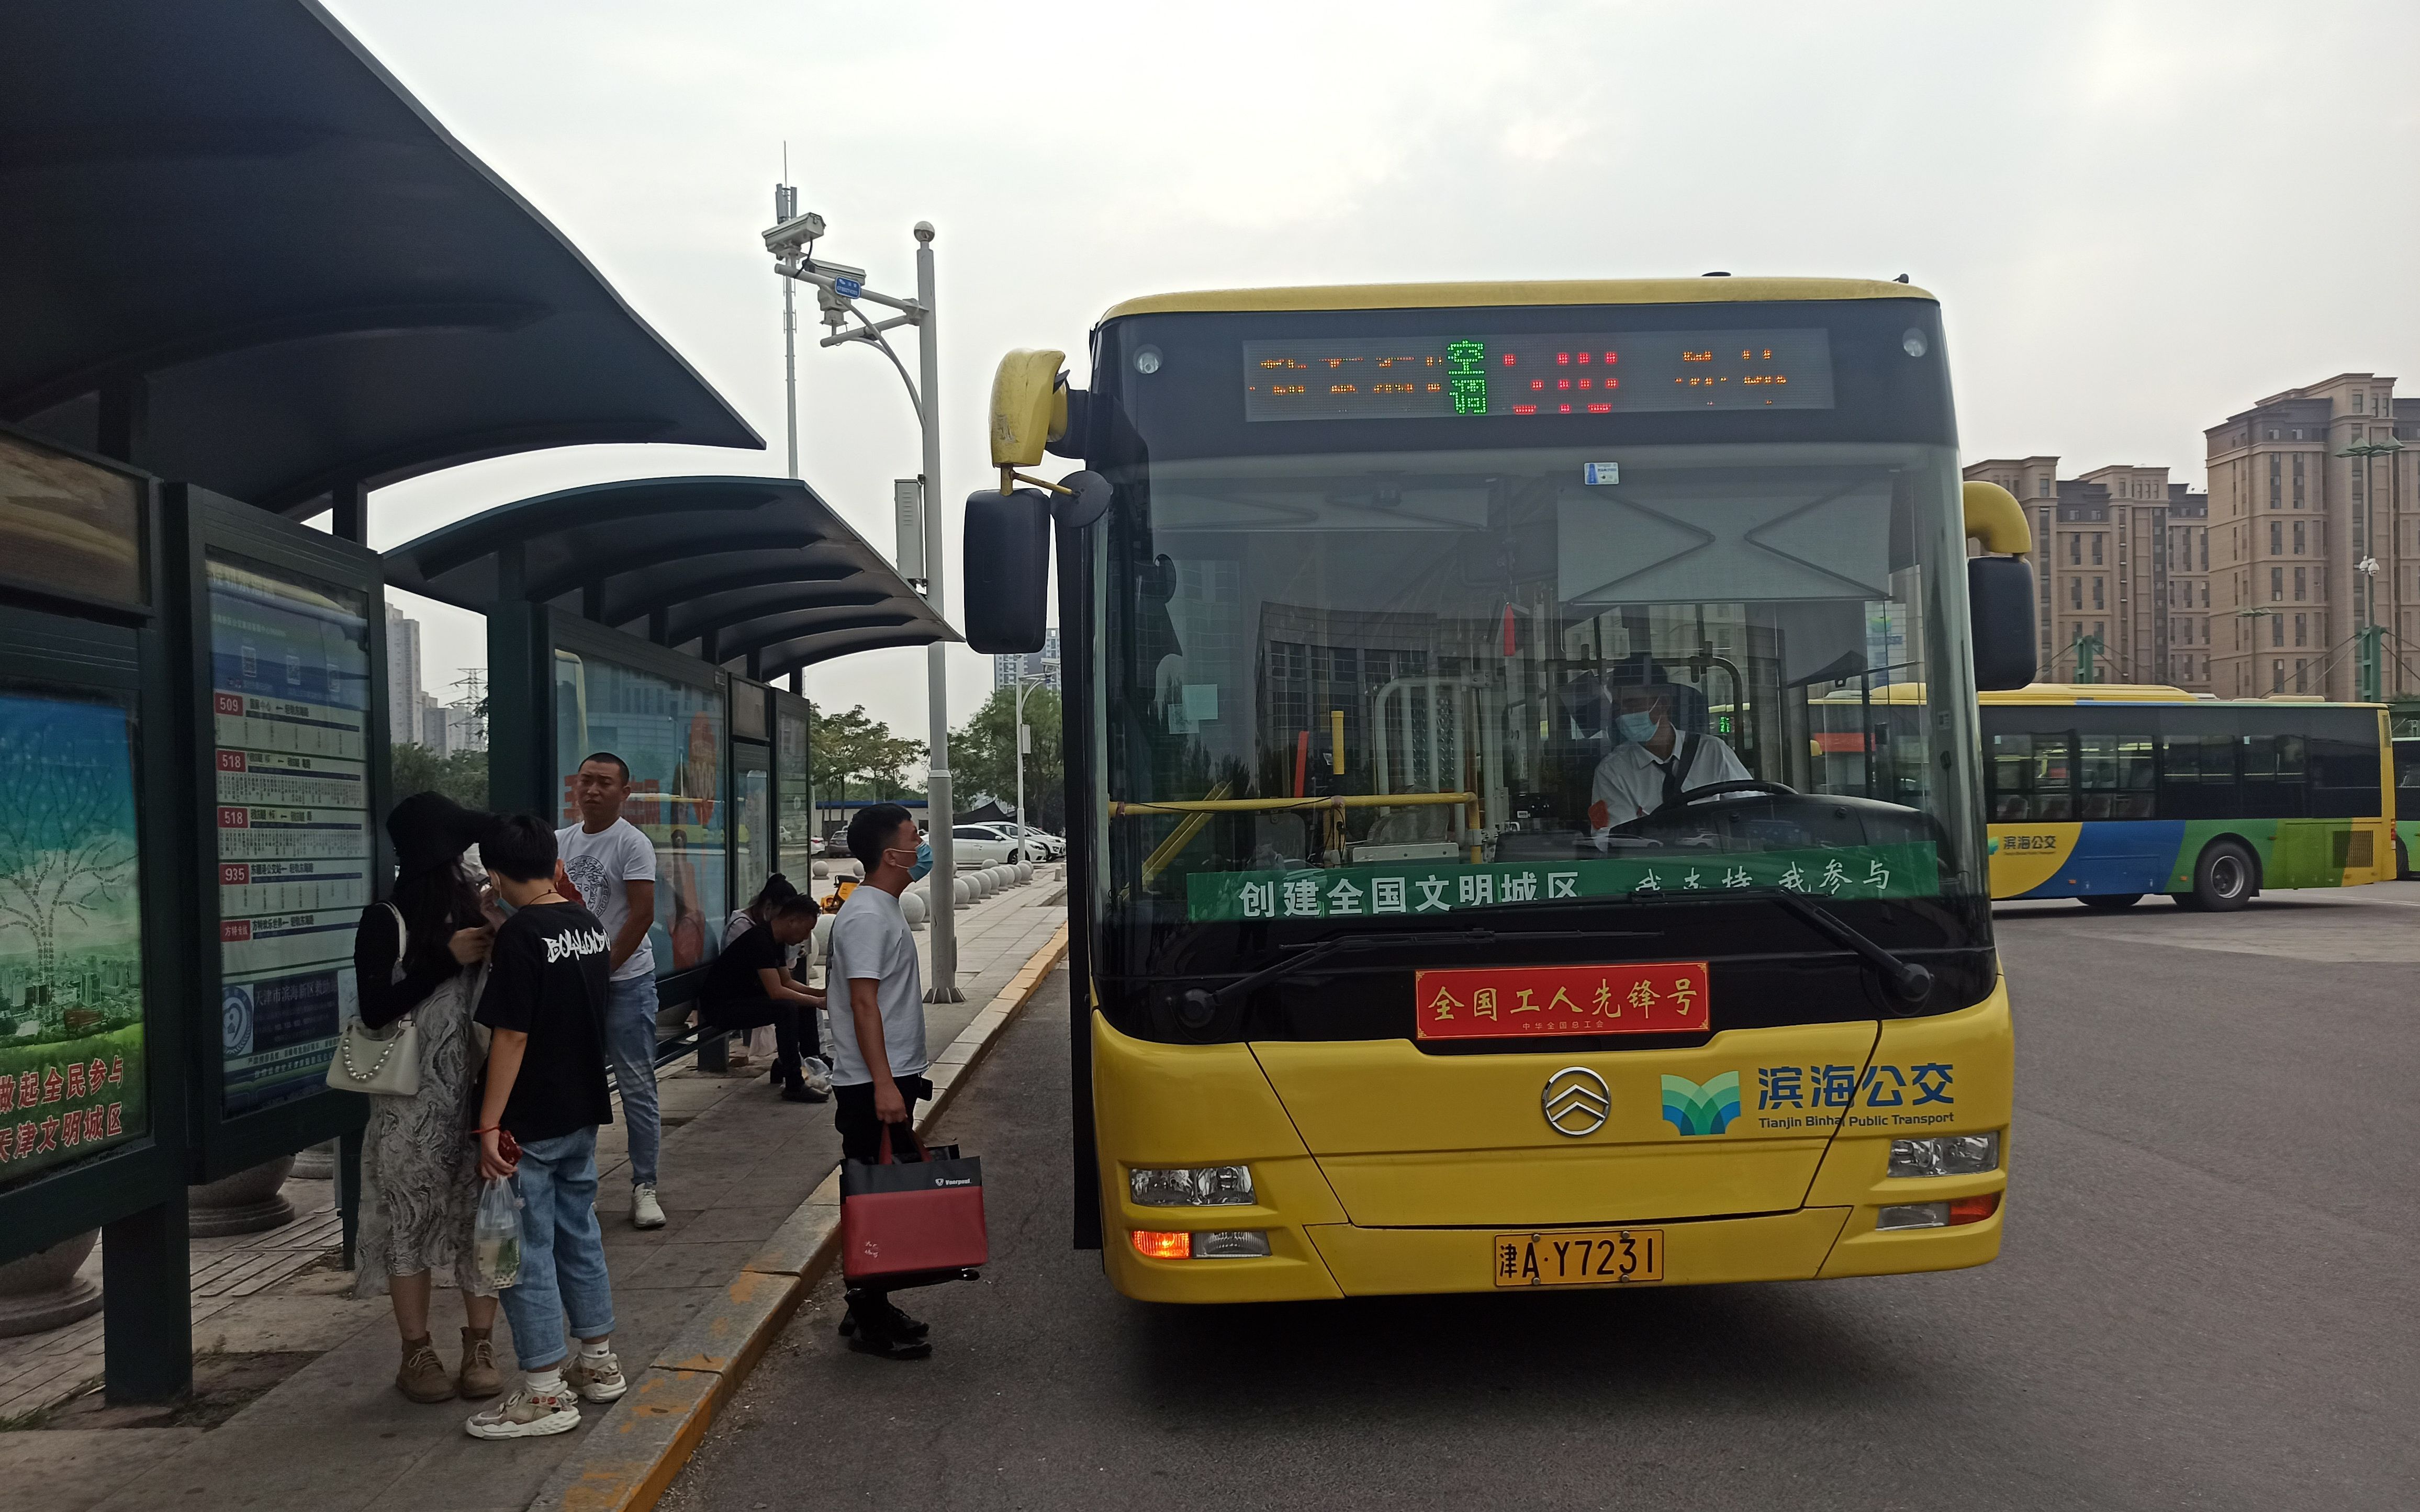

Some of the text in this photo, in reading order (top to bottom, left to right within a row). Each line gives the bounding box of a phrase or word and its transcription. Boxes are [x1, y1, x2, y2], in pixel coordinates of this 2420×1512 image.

[1447, 340, 1486, 413] 空调
[220, 697, 238, 712] 509
[222, 754, 241, 769] 518
[225, 811, 243, 825] 518
[2003, 836, 2056, 849] 滨海公交
[225, 868, 244, 882] 935
[1238, 871, 1579, 917] 创建全国文明城区
[1428, 978, 1698, 1022] 全国工人先锋号
[1522, 1020, 1605, 1030] 中华全国总工会
[1757, 1063, 1955, 1110] 滨海公交
[1758, 1118, 1802, 1130] Tianjin
[1849, 1114, 1888, 1127] Public
[1892, 1112, 1955, 1127] Transport
[1499, 1237, 1653, 1279] 津A·Y7231
